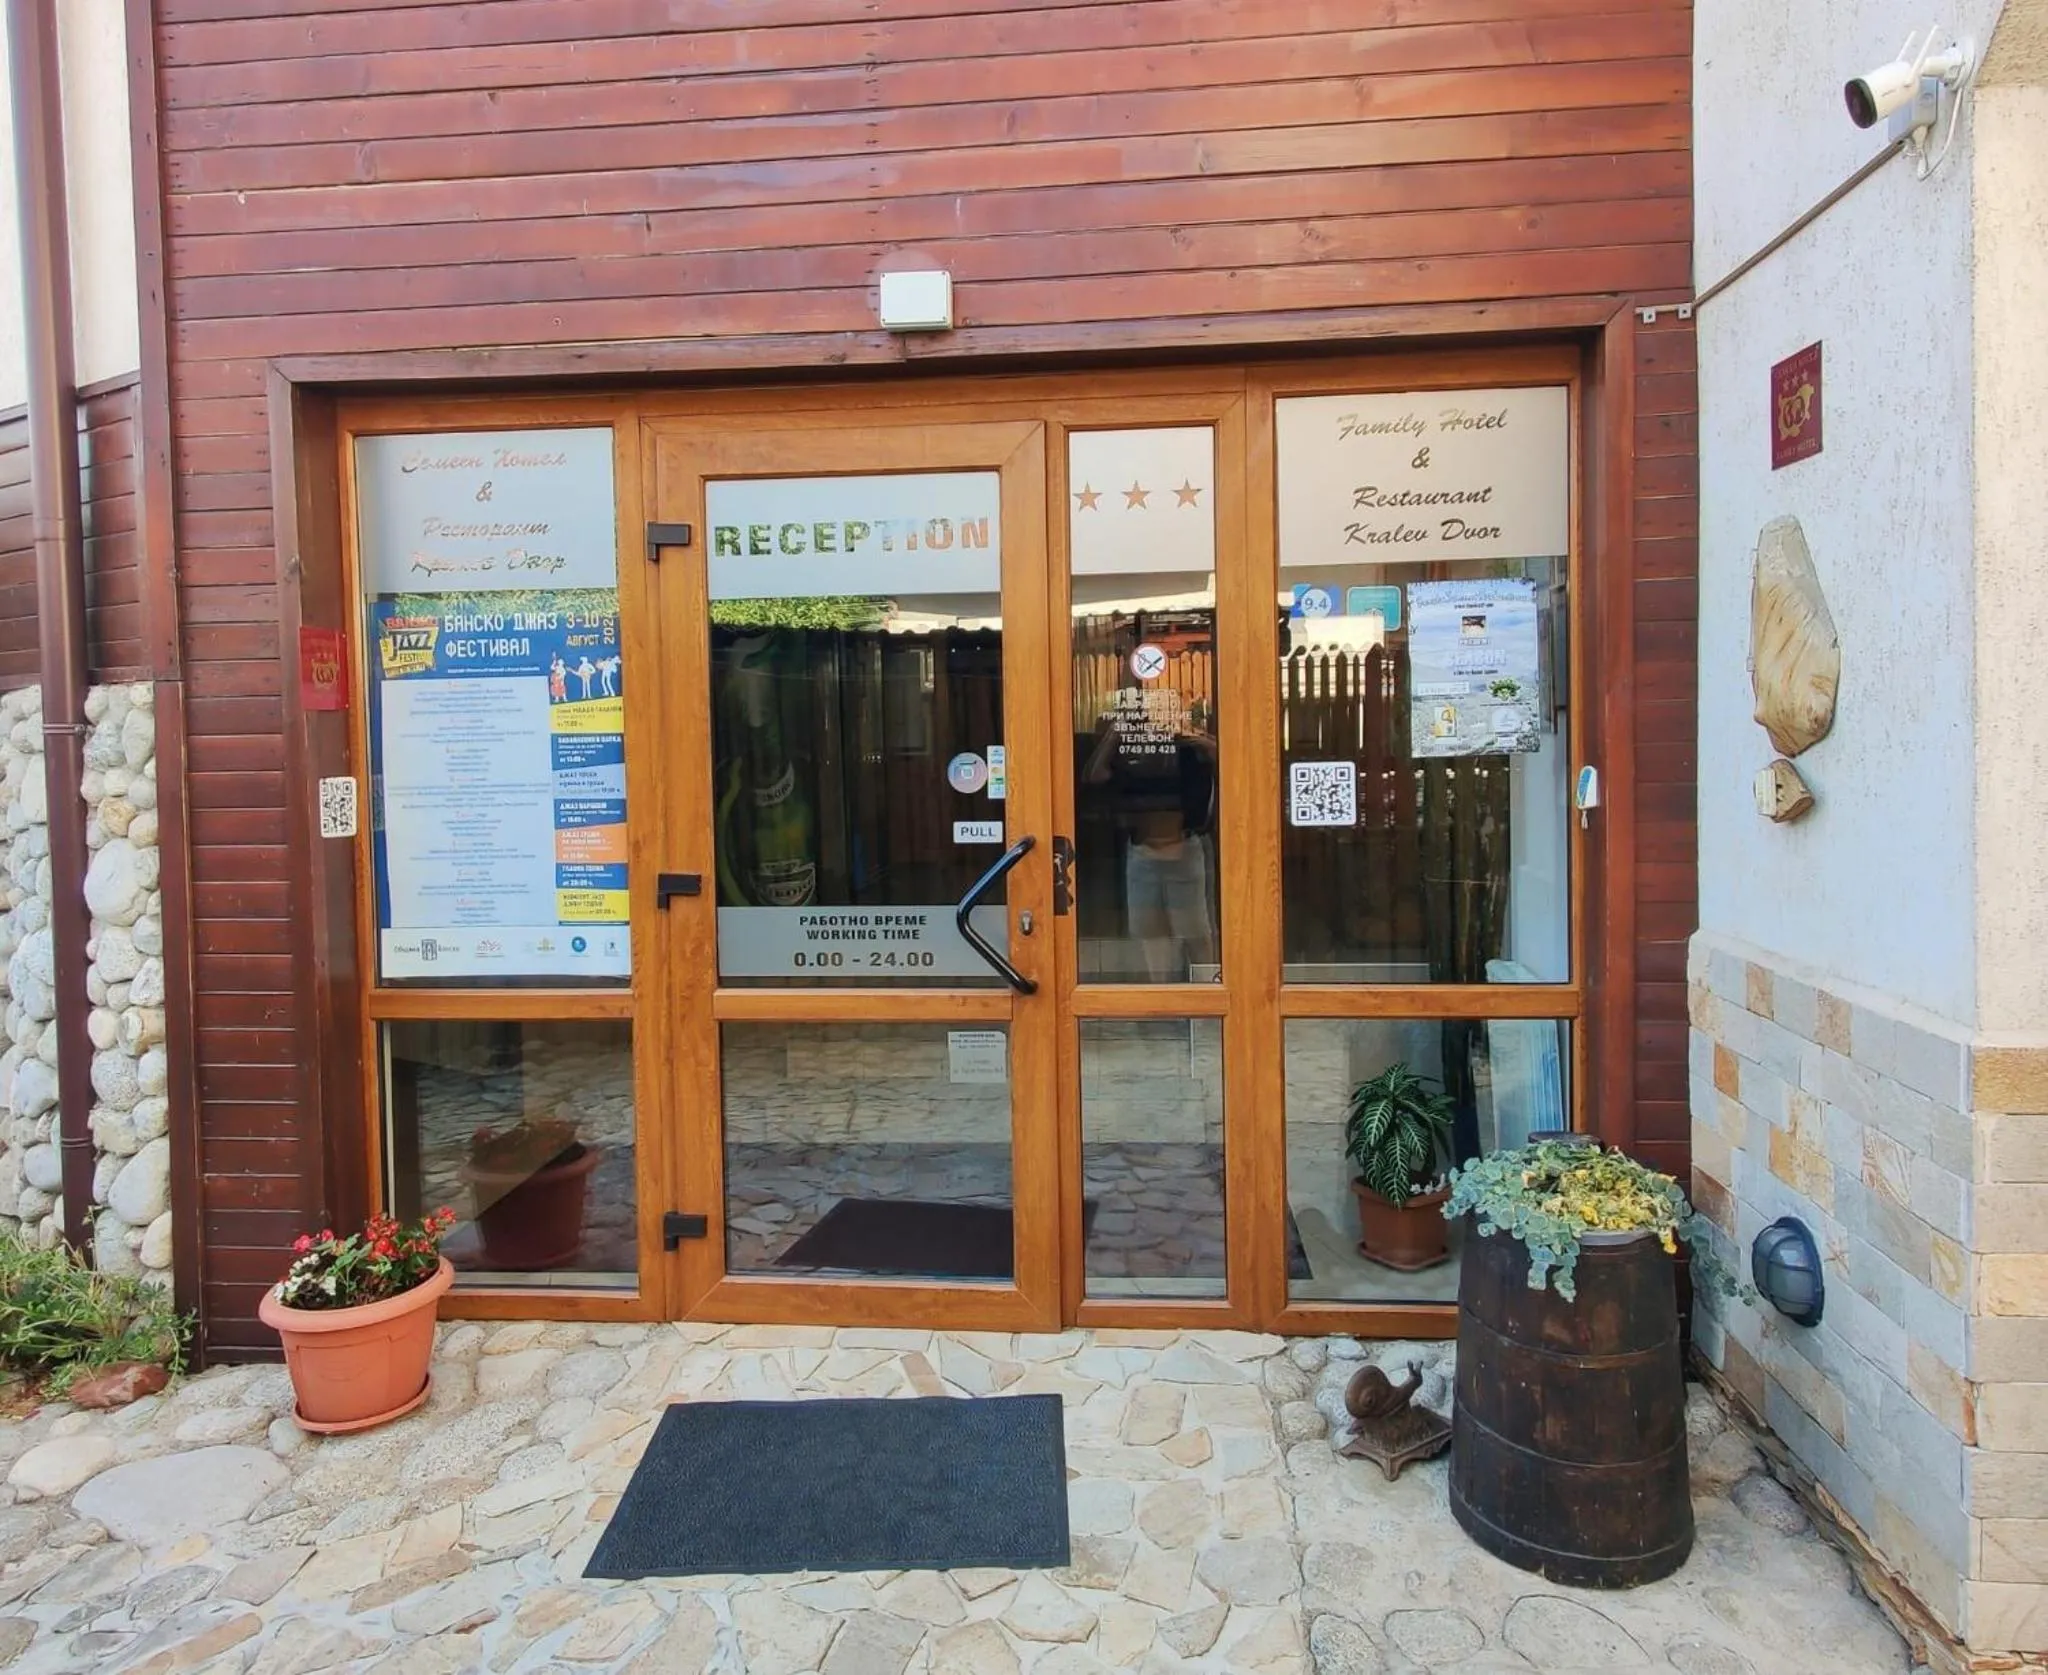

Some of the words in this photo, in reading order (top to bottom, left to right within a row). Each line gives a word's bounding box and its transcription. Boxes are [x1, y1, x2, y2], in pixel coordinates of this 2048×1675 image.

[1336, 413, 1427, 441] Family
[1439, 408, 1508, 431] Hotel
[1411, 447, 1430, 468] &
[476, 481, 492, 502] &
[1352, 486, 1493, 510] Restaurant
[714, 517, 990, 557] RECEPTION
[1344, 522, 1429, 545] Kralev
[1440, 518, 1502, 541] Dvor
[1304, 598, 1328, 611] 9.4
[444, 614, 504, 633] БАНСКО
[513, 612, 557, 631] ДЖАЗ
[445, 637, 531, 658] ФЕСТИВАЛ
[566, 634, 600, 647] АВГУСТ
[1102, 711, 1125, 721] ПРИ
[960, 826, 997, 837] PULL
[800, 915, 869, 927] РАБОТНО
[874, 915, 928, 926] ВРЕМЕ
[807, 929, 877, 941] WORKING
[883, 929, 920, 940] TIME
[793, 952, 844, 967] 0.00
[869, 952, 935, 967] 24.00
